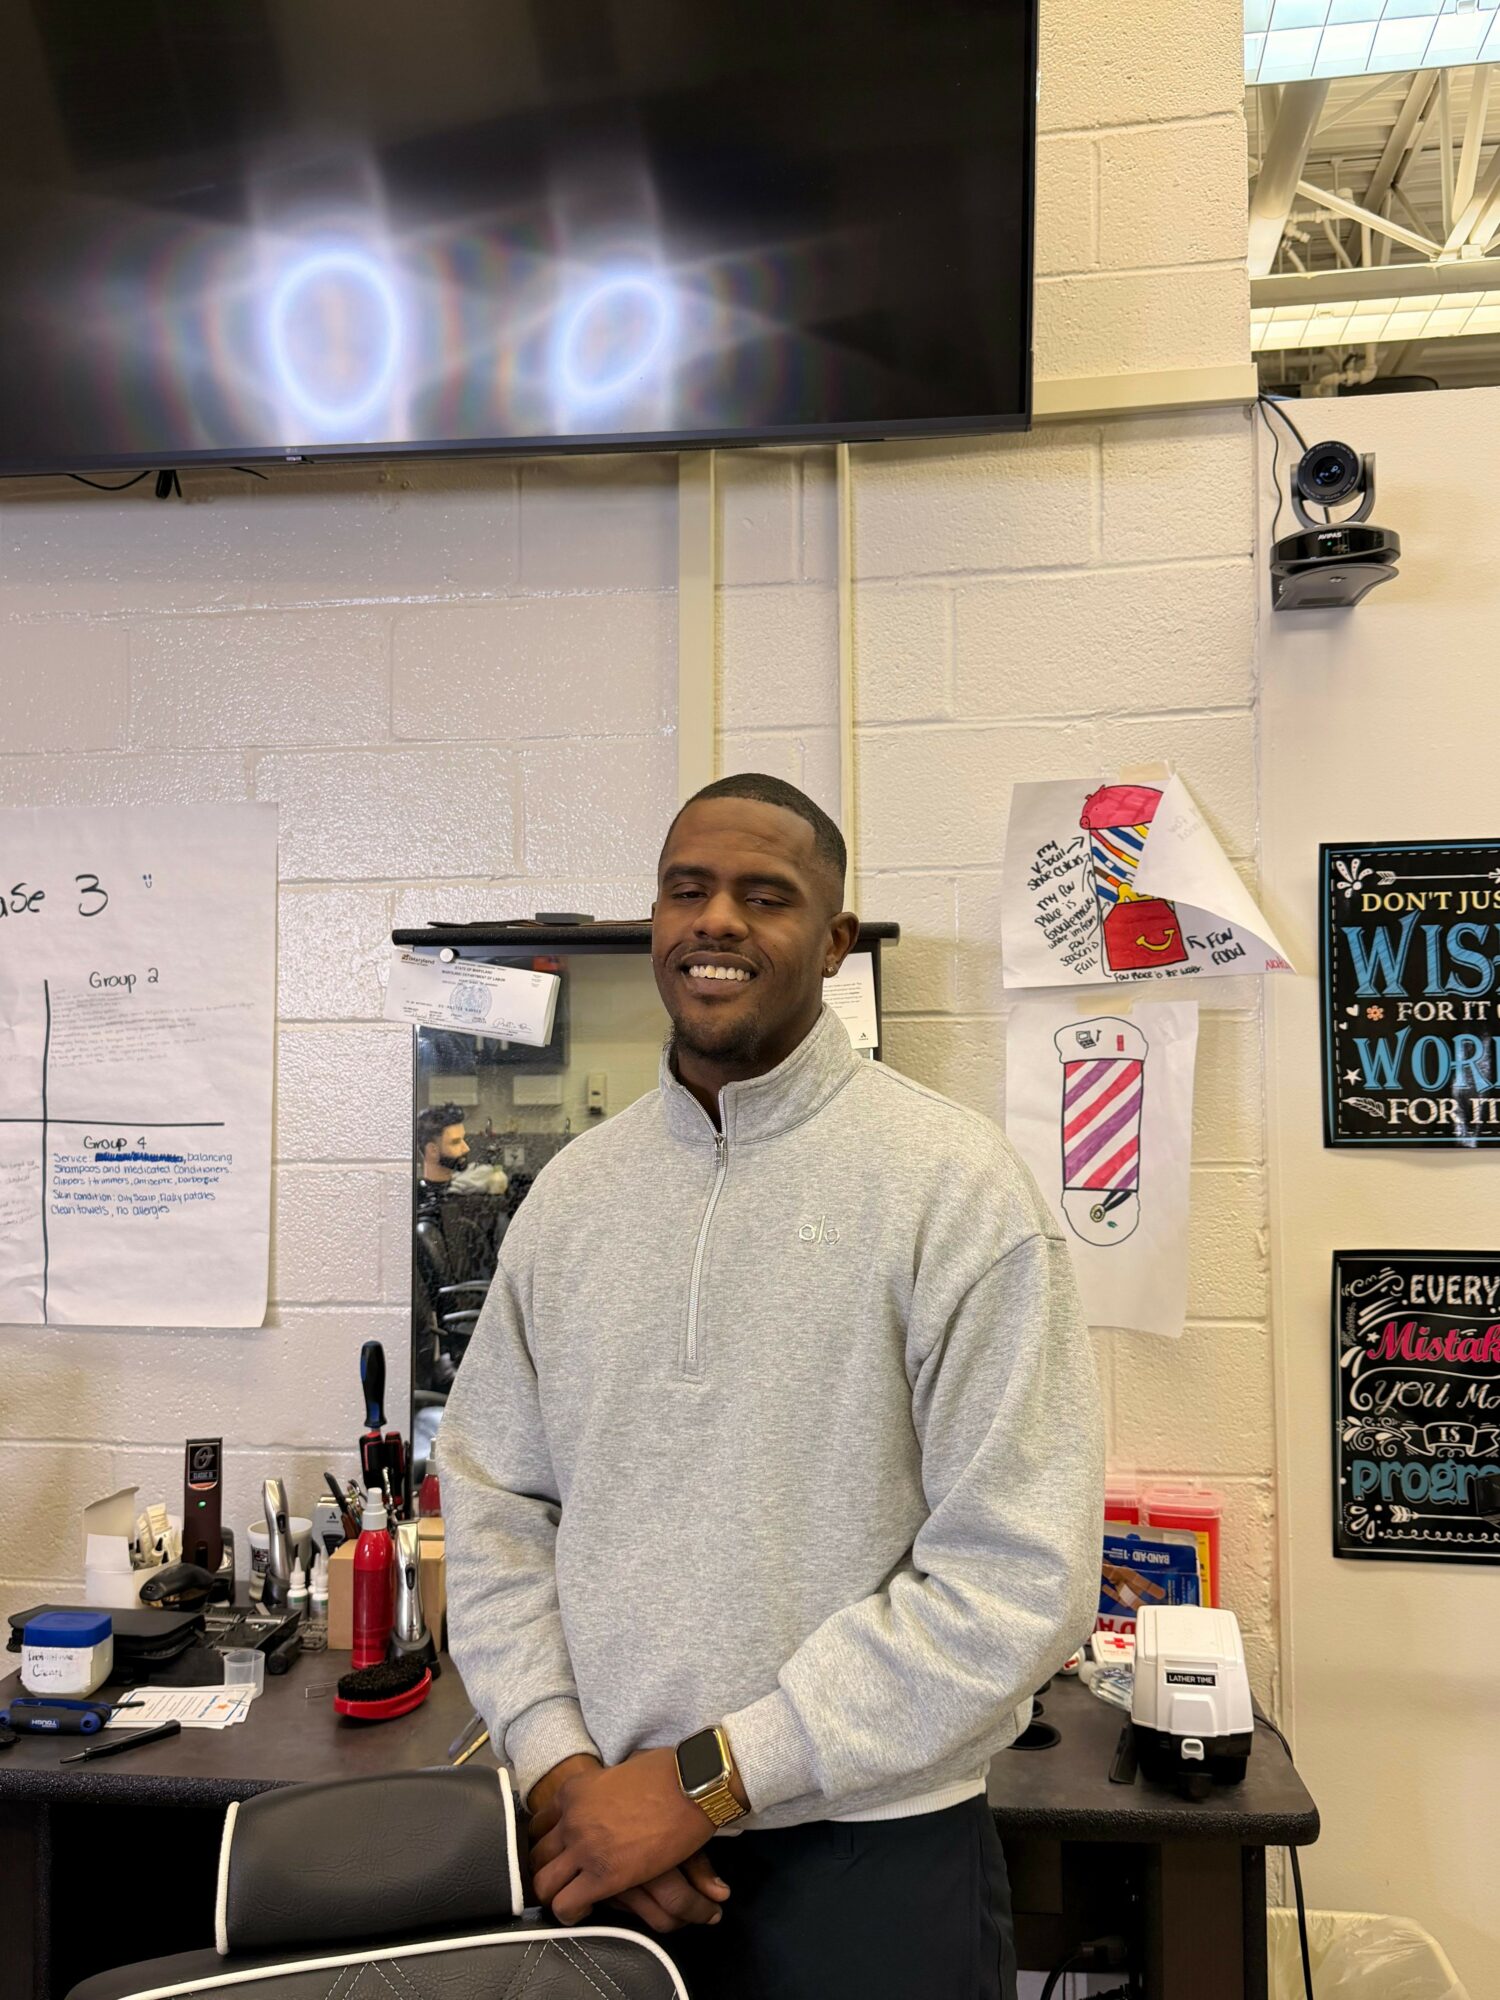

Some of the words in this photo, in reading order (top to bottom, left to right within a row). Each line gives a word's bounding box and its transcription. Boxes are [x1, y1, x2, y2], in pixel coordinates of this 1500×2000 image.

[1318, 532, 1342, 541] AVIPAS
[75, 874, 109, 917] 3
[1361, 891, 1453, 913] DON'T
[1341, 909, 1500, 998] WIS
[89, 971, 137, 994] Group
[147, 967, 159, 984] 2
[1396, 1001, 1458, 1022] FOR
[1462, 1000, 1492, 1021] IT
[1352, 1025, 1500, 1094] WOR
[1387, 1098, 1464, 1125] FOR
[84, 1136, 127, 1152] Group
[137, 1136, 148, 1150] 4
[102, 1164, 120, 1174] and
[116, 1205, 130, 1215] no
[1410, 1274, 1500, 1305] EVERY
[1438, 1426, 1461, 1443] IS
[1132, 1550, 1171, 1565] BAND-AID
[1168, 1674, 1196, 1683] LATHER
[1196, 1676, 1214, 1684] TIME
